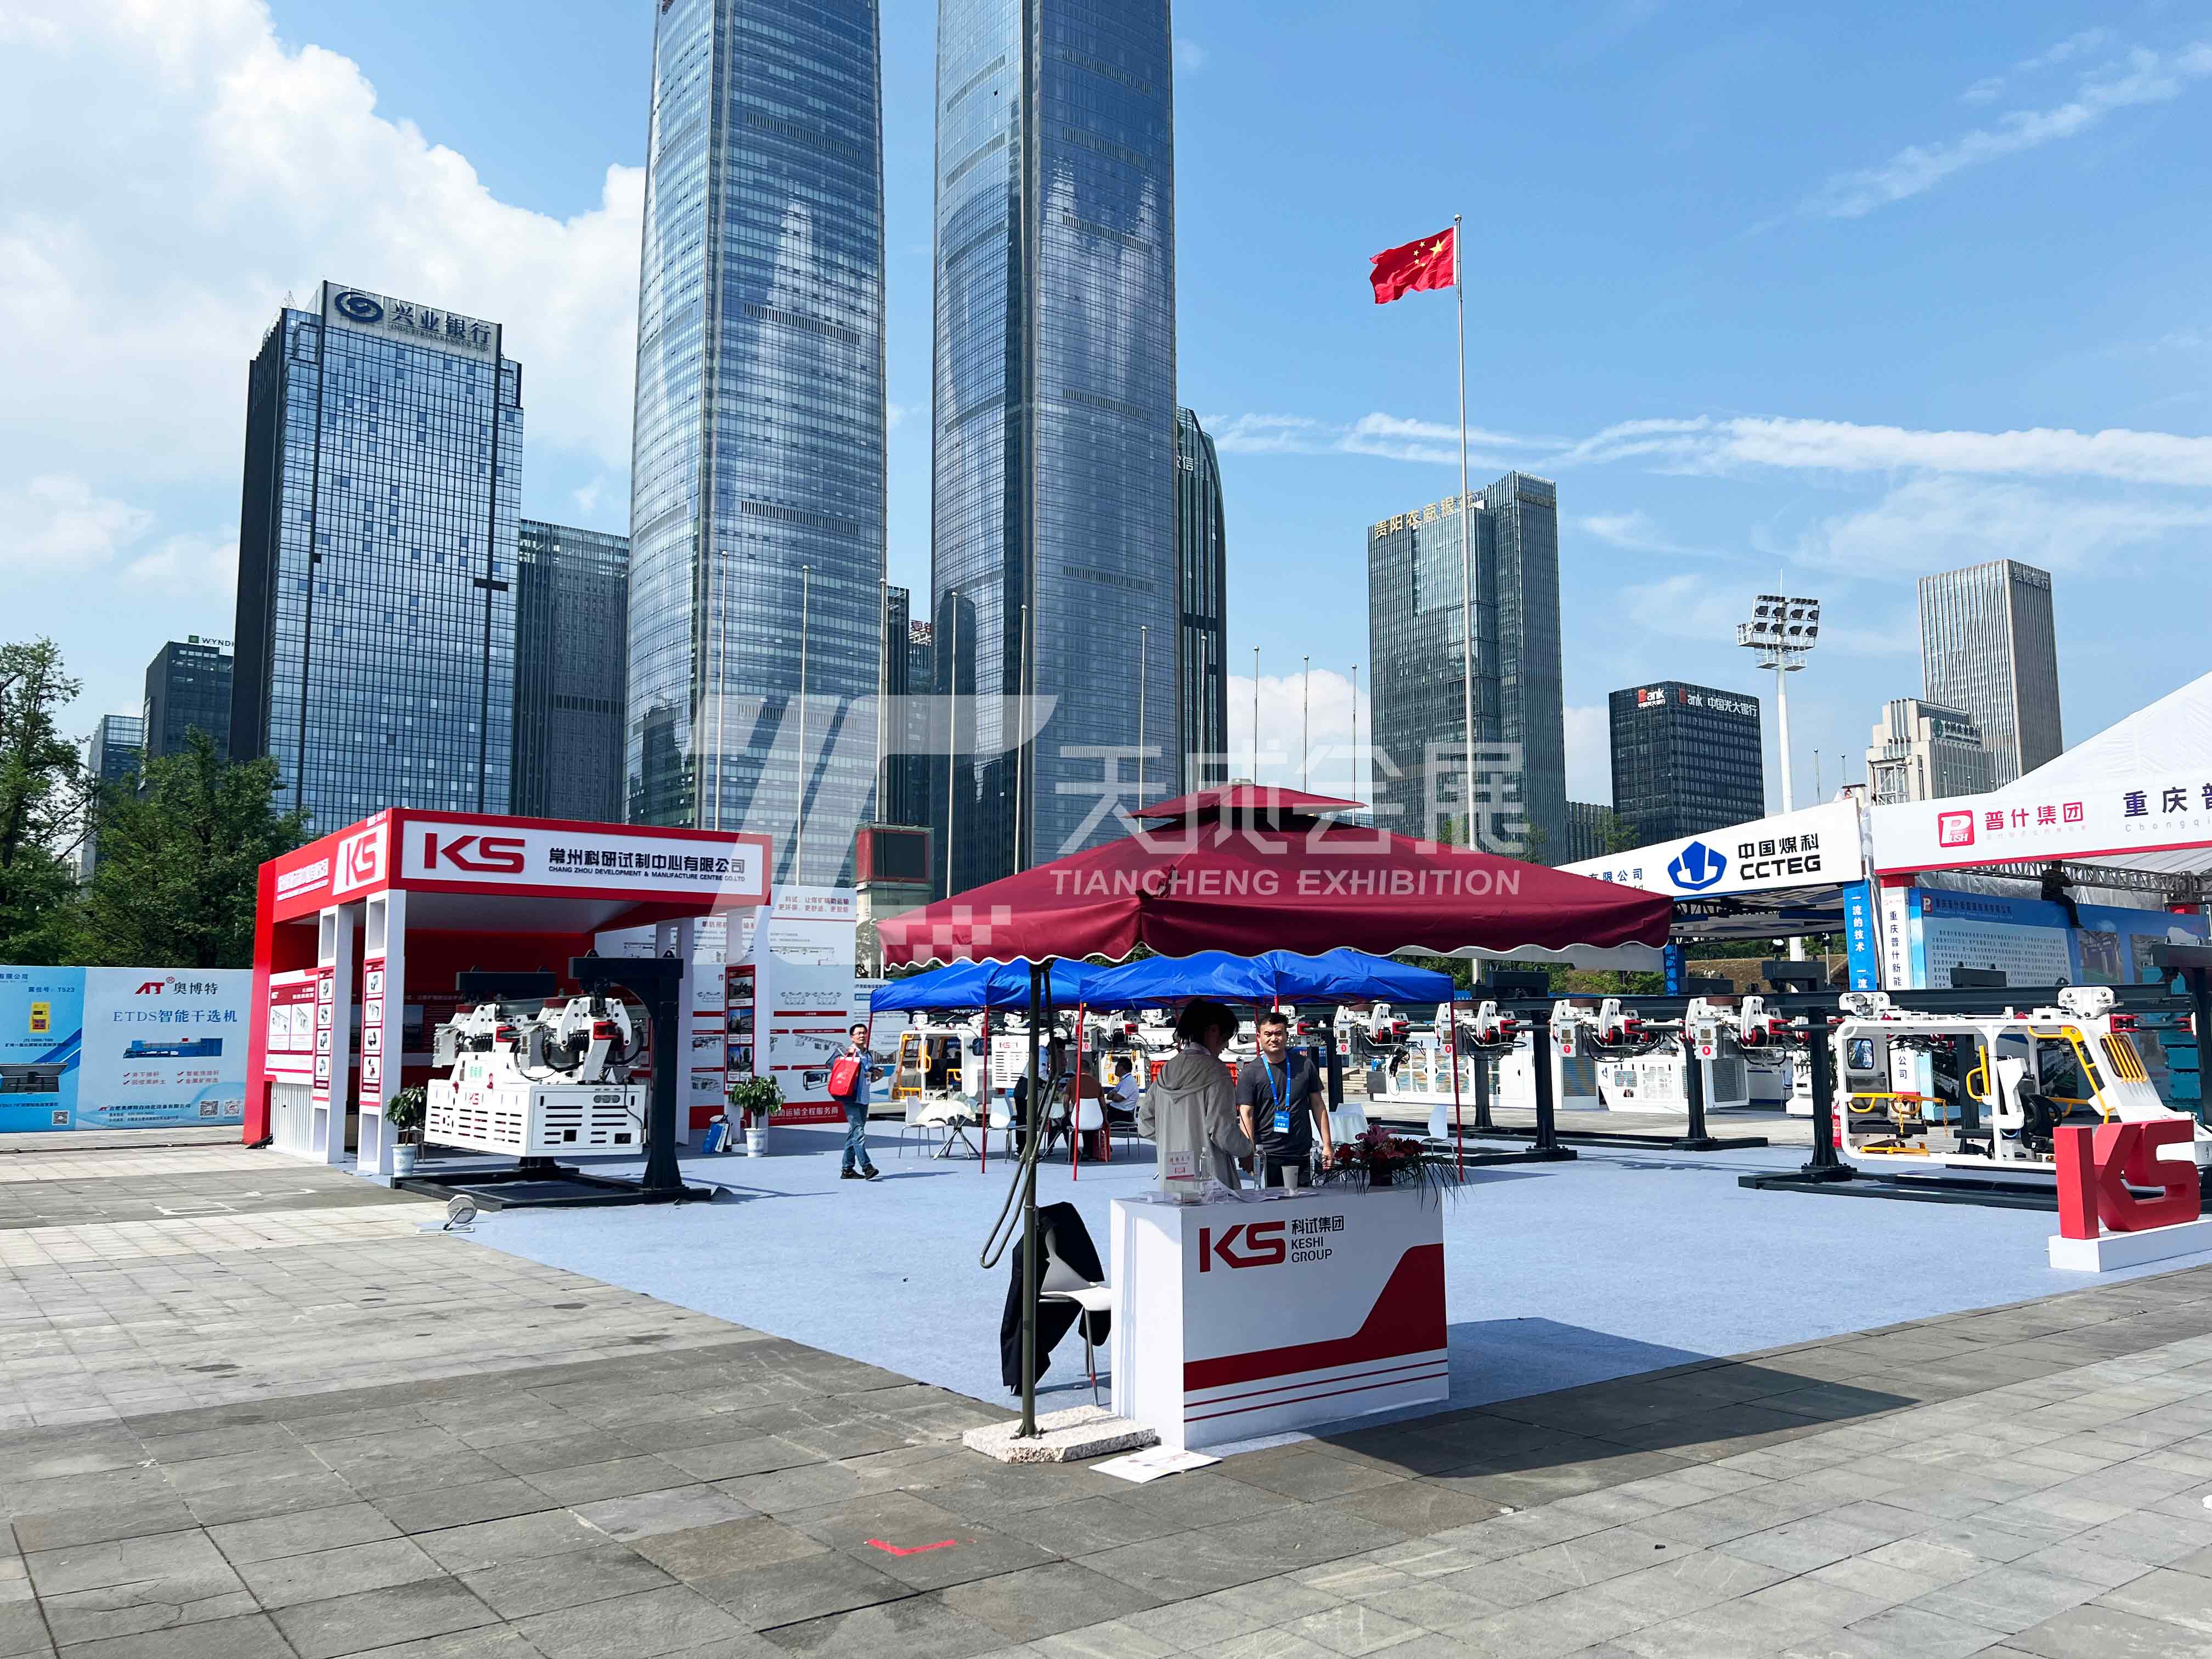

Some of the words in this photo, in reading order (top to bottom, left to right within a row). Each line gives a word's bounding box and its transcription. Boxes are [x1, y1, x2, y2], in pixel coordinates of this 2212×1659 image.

[390, 303, 491, 343] 兴业银行
[391, 324, 438, 340] INDUSTRIAL
[440, 336, 460, 345] BANK
[1375, 492, 1474, 539] 贵阳农商银行
[1707, 697, 1757, 717] 中国光大银行
[1985, 802, 2084, 831] 普什集团
[346, 832, 378, 886] KS
[424, 832, 525, 873] KS
[1737, 833, 1819, 860] 中国煤科
[549, 848, 746, 873] 常州科研试制中心有限公司
[1740, 855, 1821, 881] CCTEG
[1851, 896, 1865, 952] 一流的技术
[1889, 911, 1902, 986] 重庆普什新能
[173, 981, 219, 995] 奥博特
[1857, 969, 1868, 989] 一流
[114, 1009, 238, 1023] ETDS智能干选机
[1898, 1048, 1908, 1079] 公司
[771, 1106, 838, 1117] 助运输全程服务商
[2053, 1119, 2202, 1240] KS
[1291, 1215, 1344, 1234] 科试集团
[1199, 1221, 1286, 1273] KS
[1291, 1237, 1323, 1250] KESHI
[1291, 1249, 1333, 1263] GROUP
